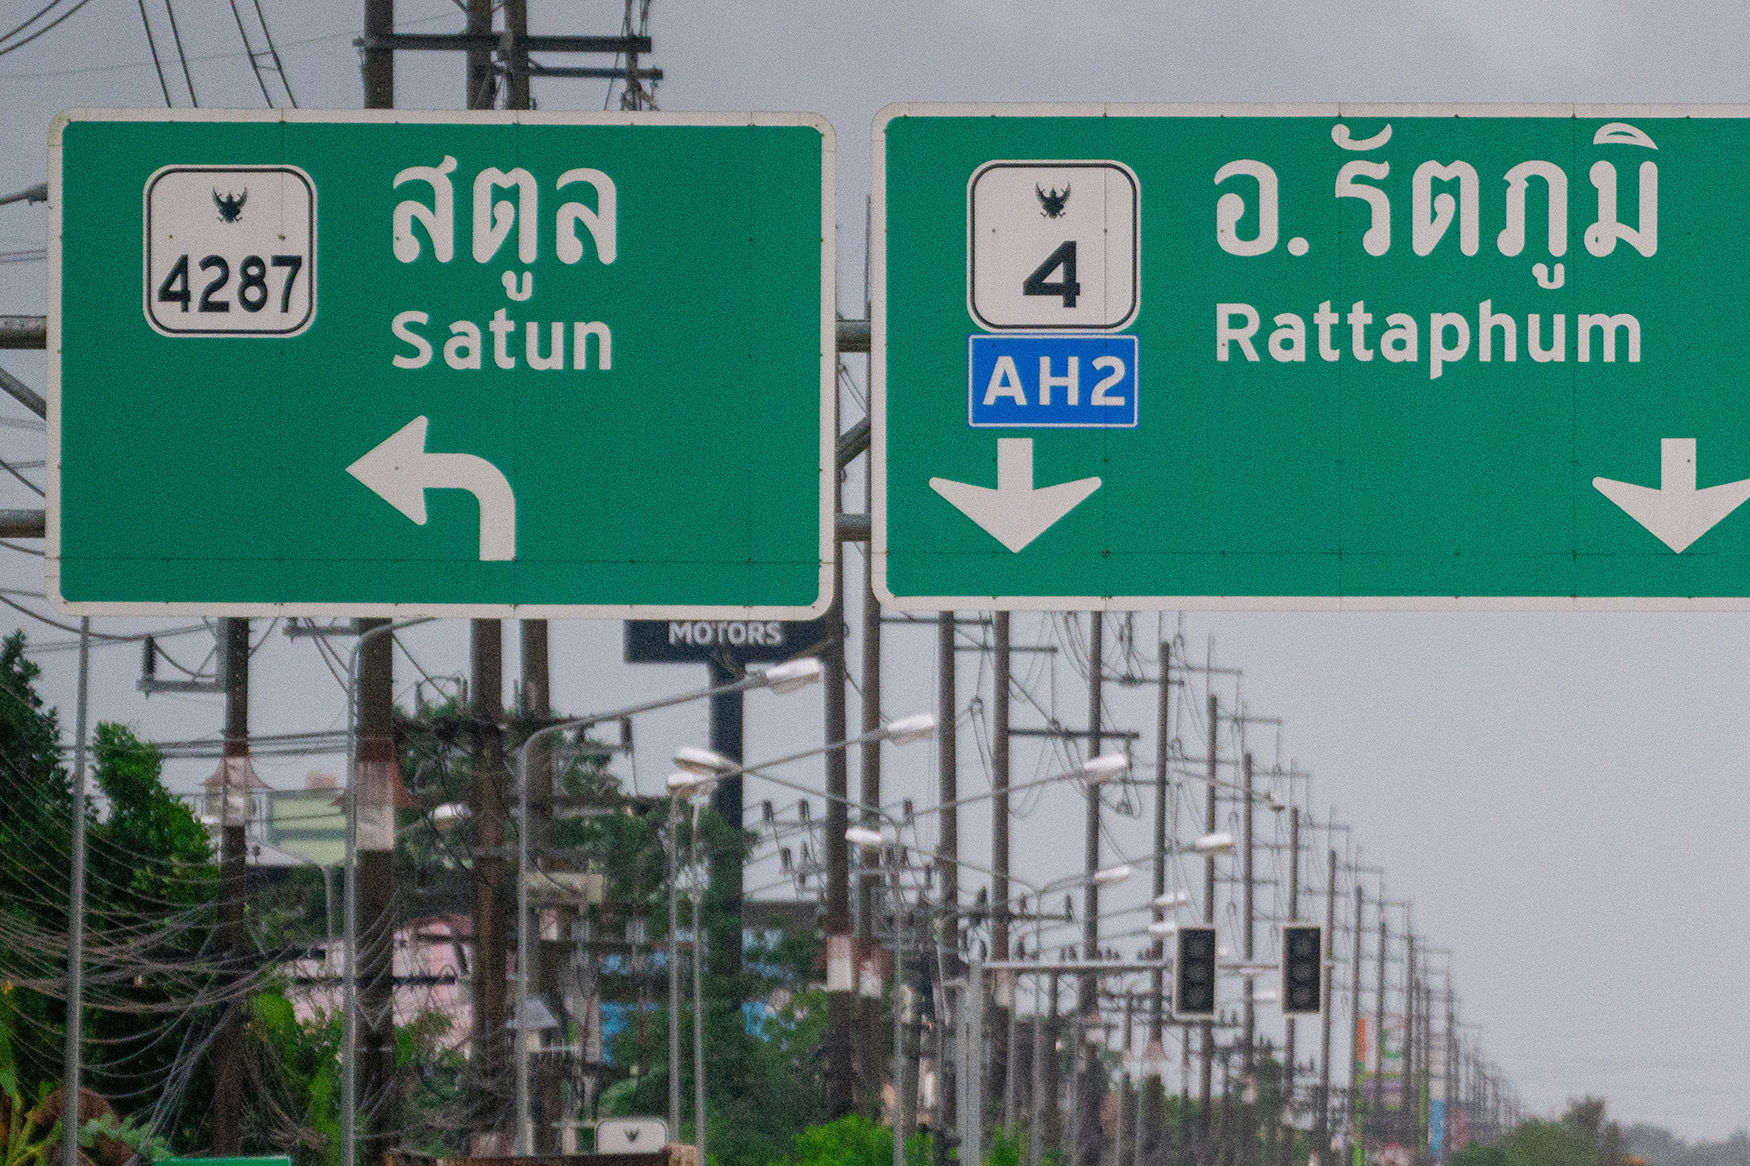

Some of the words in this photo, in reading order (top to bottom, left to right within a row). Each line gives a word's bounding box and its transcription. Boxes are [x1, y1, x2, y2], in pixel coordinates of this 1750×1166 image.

[393, 155, 618, 302] สตูล
[158, 254, 303, 314] 4287
[1022, 240, 1081, 308] 4
[391, 306, 613, 371] Satun
[1215, 299, 1642, 380] Rattaphum
[982, 355, 1127, 406] AH2
[669, 621, 783, 646] MOTORS
